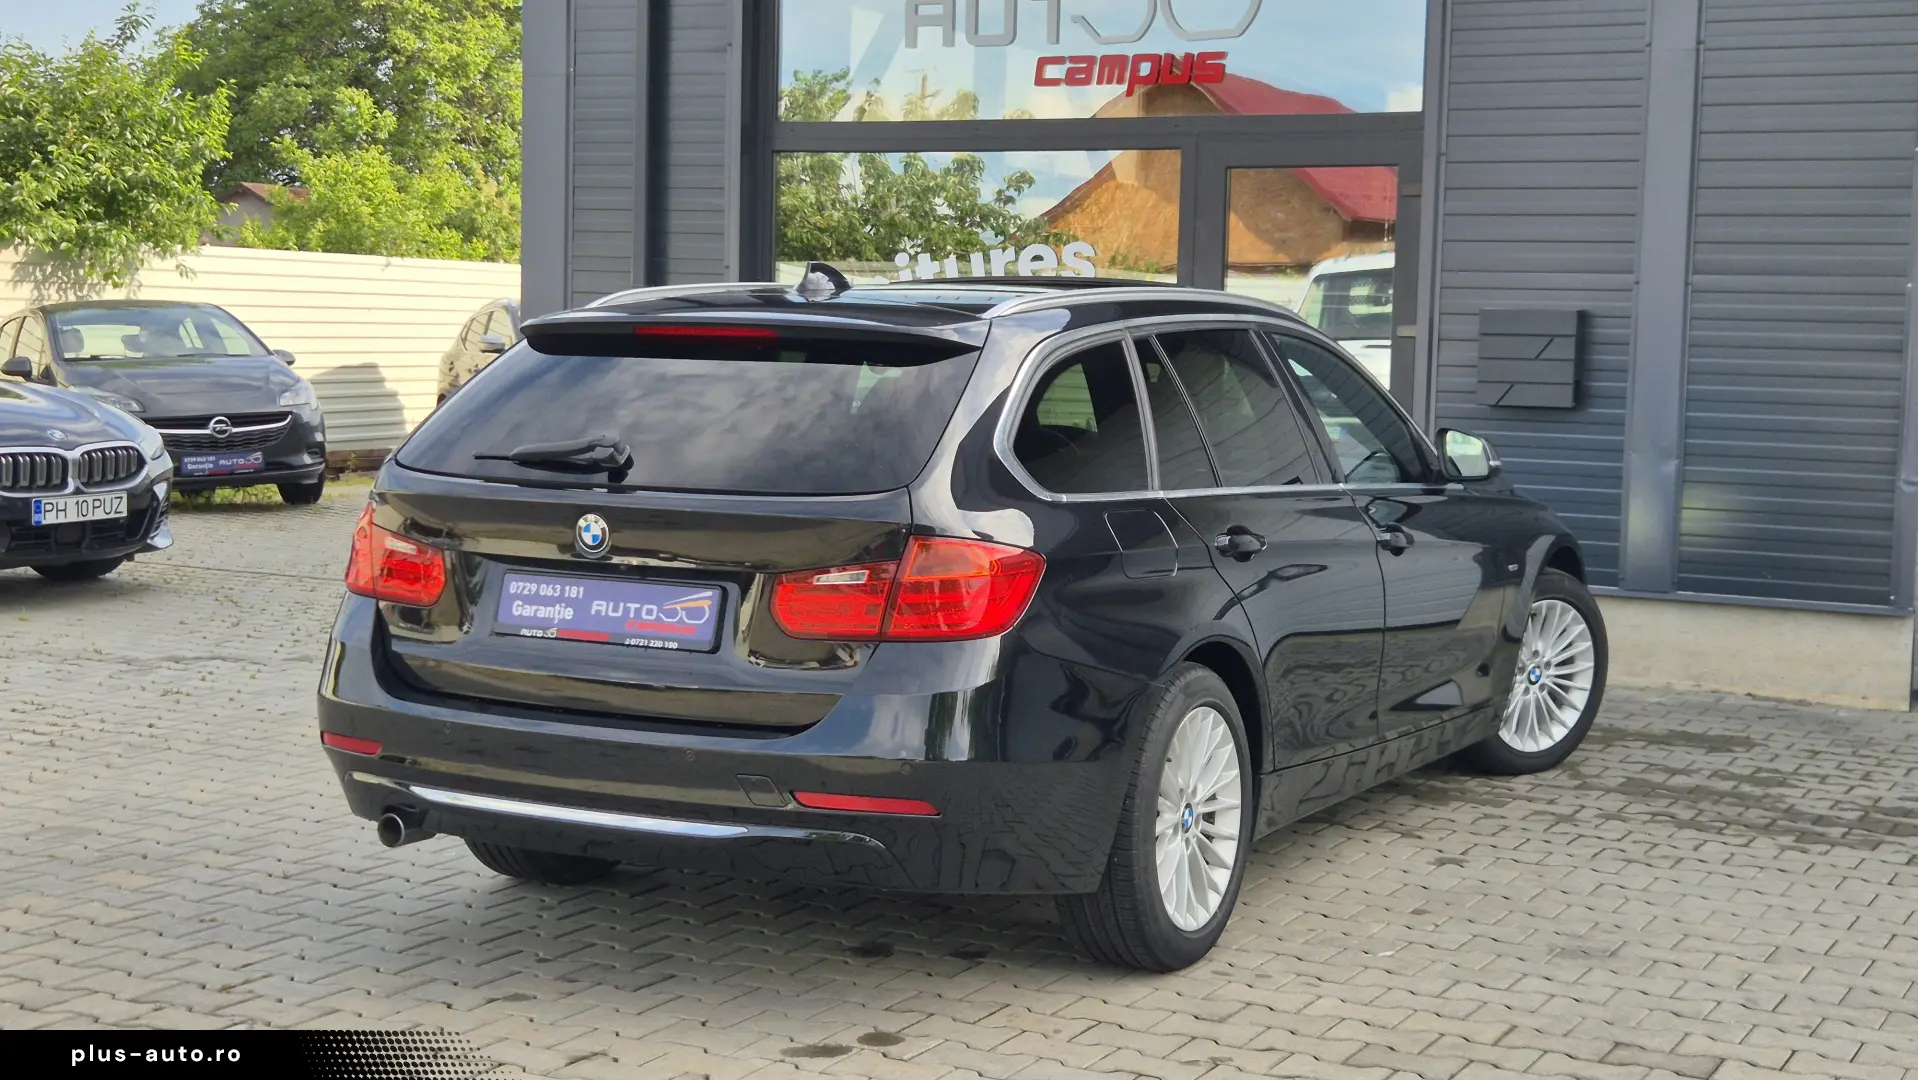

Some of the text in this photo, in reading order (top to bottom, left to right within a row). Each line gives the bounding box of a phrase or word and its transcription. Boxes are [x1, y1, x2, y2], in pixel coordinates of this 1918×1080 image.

[1033, 51, 1229, 97] campus
[43, 501, 67, 520] PH
[75, 499, 89, 518] 10
[92, 496, 124, 516] PUZ
[509, 581, 585, 599] 0729 063 181
[512, 599, 574, 624] Garanție
[591, 600, 658, 620] AUTO
